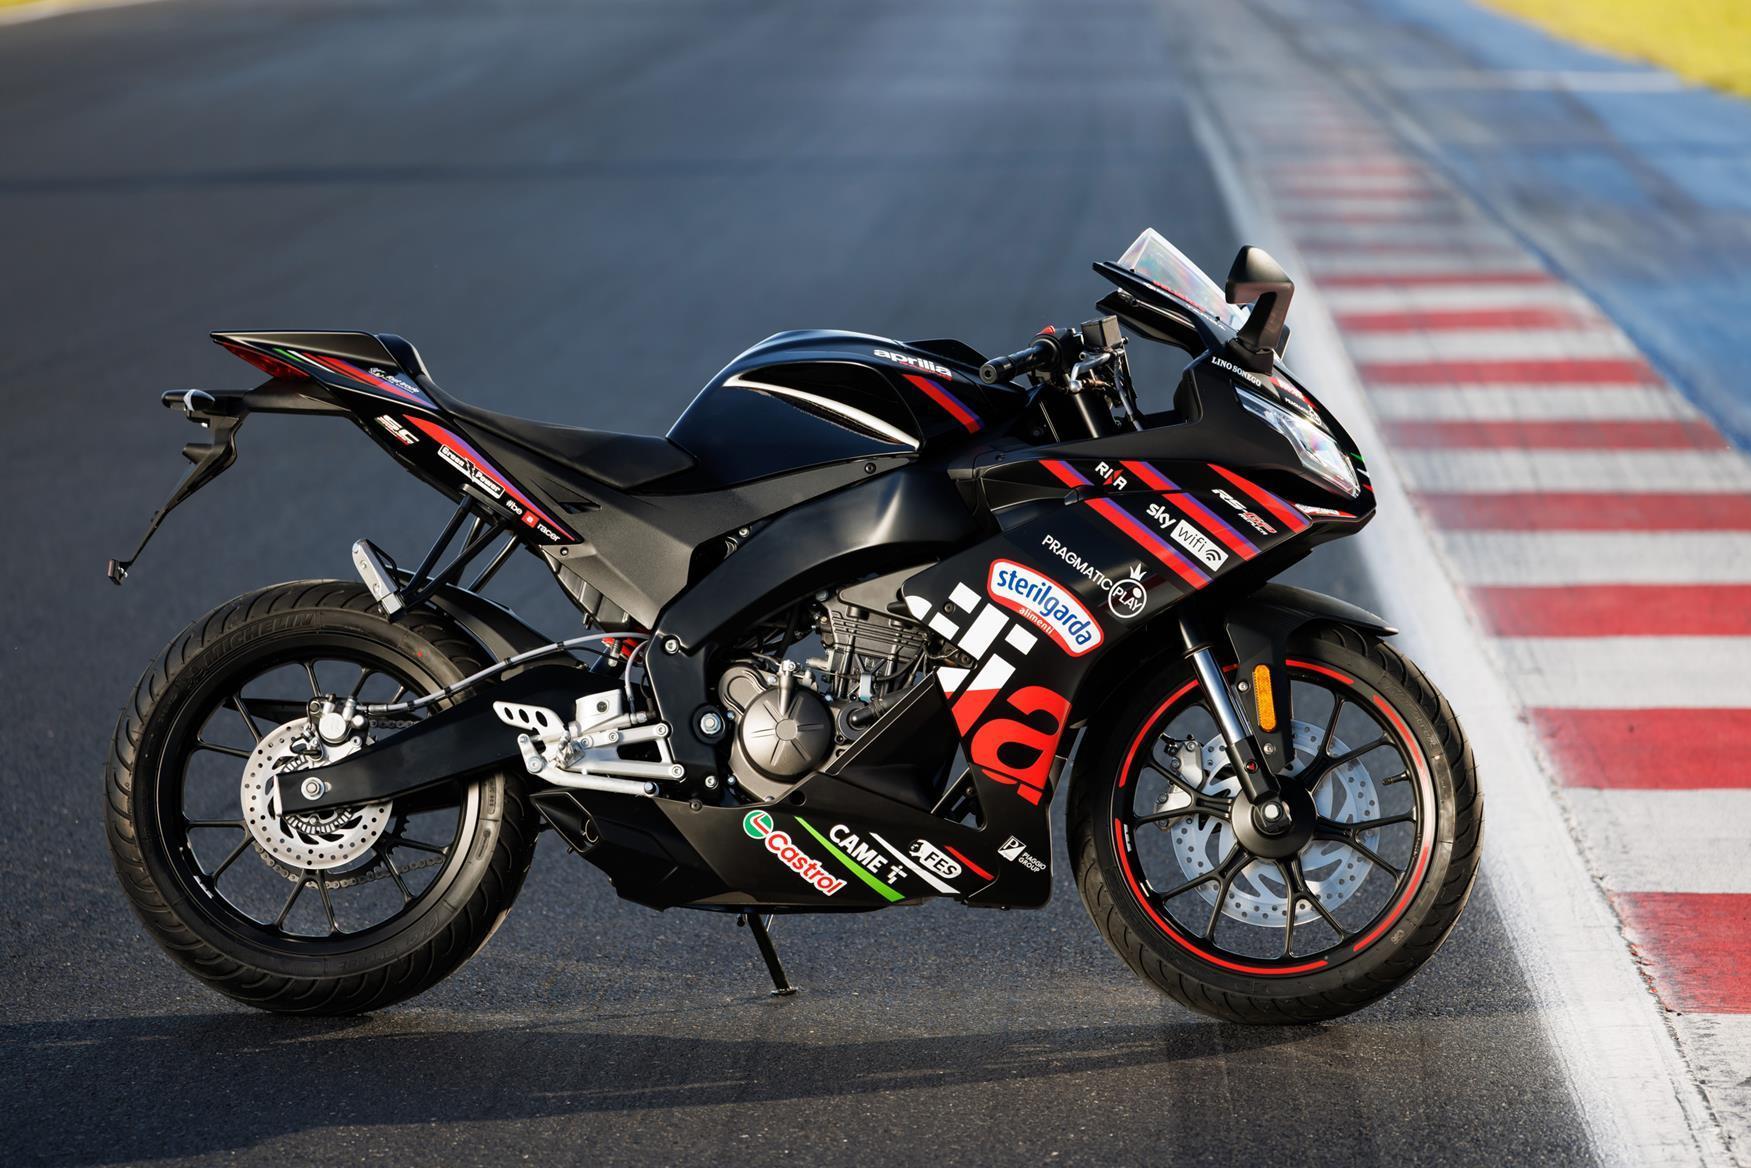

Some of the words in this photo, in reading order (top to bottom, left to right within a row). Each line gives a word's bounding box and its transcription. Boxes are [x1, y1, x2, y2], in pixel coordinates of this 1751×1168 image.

[873, 349, 952, 379] aprilia
[1211, 356, 1232, 371] LINO
[1232, 365, 1262, 387] SONEGO
[442, 446, 466, 467] Green
[475, 471, 501, 492] Power
[537, 523, 561, 542] racer
[1146, 502, 1176, 529] sky
[1177, 526, 1207, 553] wifi
[1041, 534, 1113, 591] PRAGMATIC
[1112, 586, 1142, 612] PLAY
[997, 569, 1092, 645] sterilgarda
[1018, 606, 1055, 635] alimenti
[766, 831, 846, 895] Castrol
[830, 824, 888, 873] CAME
[923, 851, 958, 877] FES
[1021, 851, 1047, 870] PIAGGIO
[1018, 857, 1041, 873] GROUP
